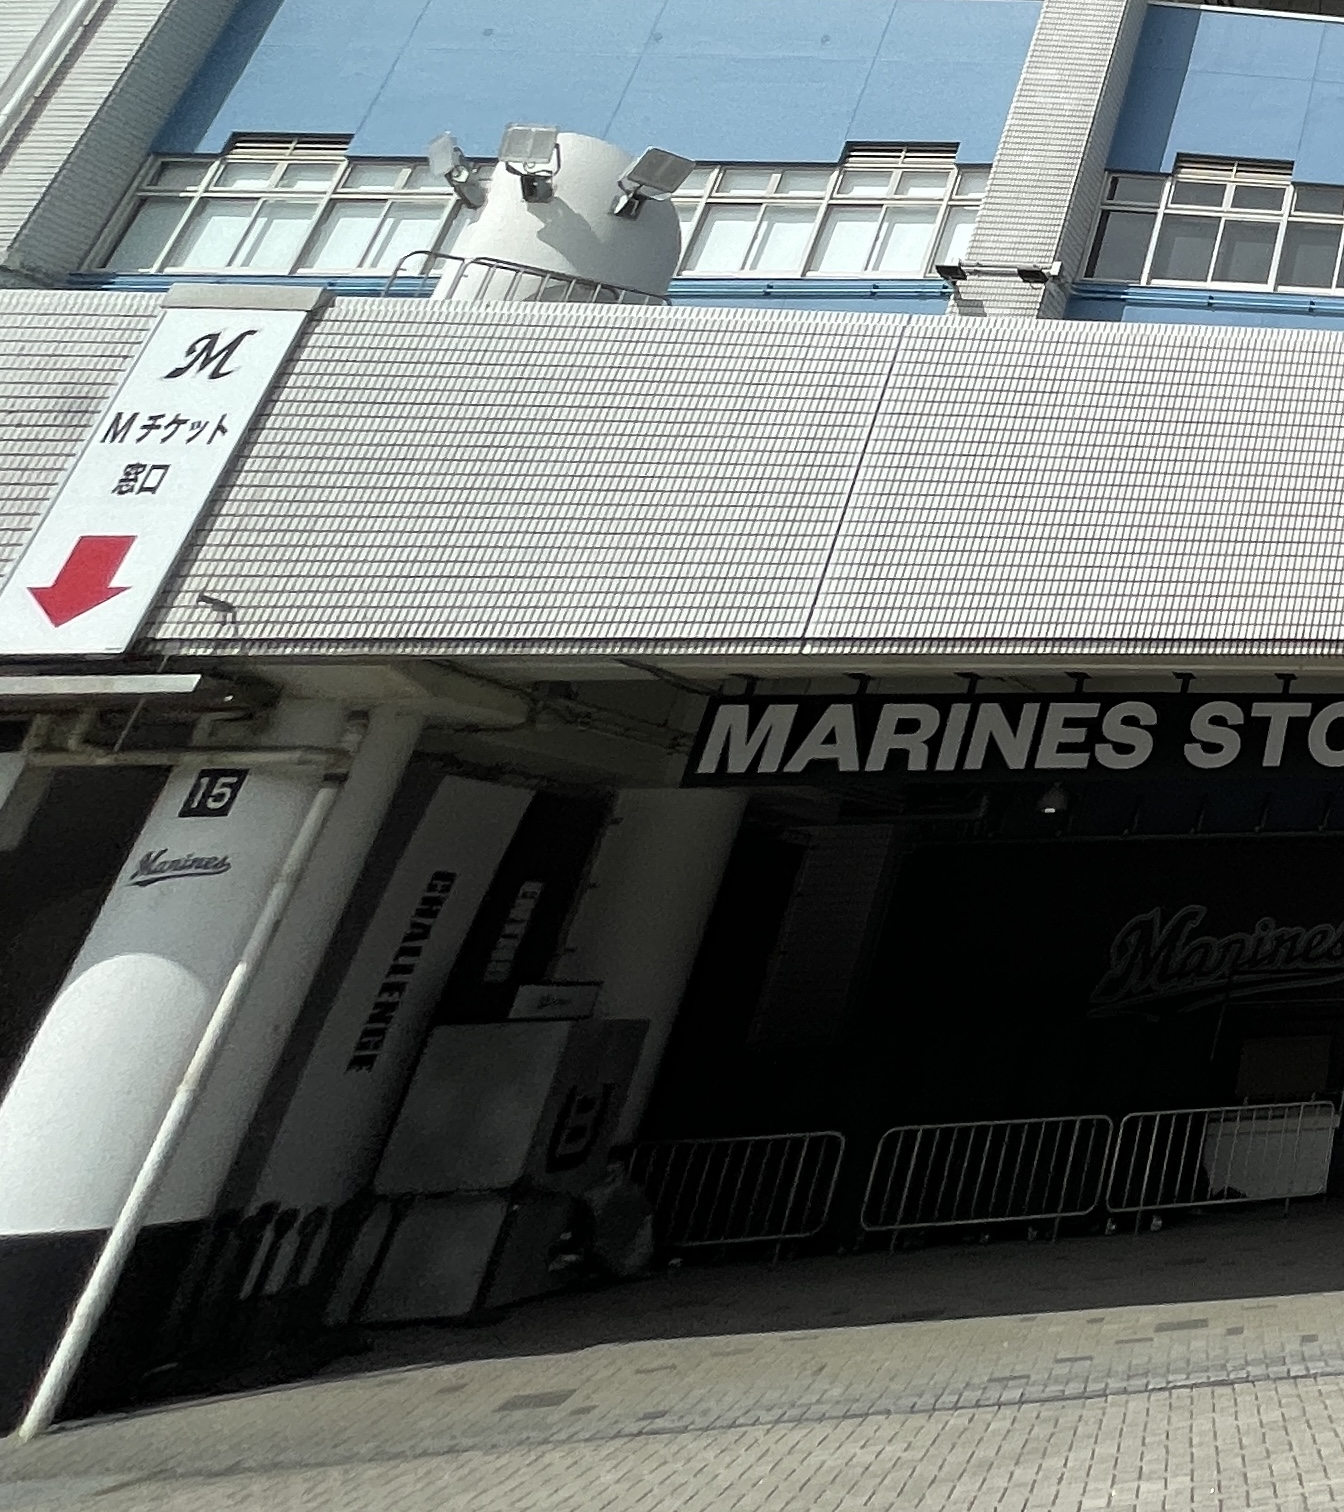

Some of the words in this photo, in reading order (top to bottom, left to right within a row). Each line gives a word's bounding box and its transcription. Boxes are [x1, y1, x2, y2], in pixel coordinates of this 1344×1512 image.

[162, 328, 259, 380] M
[111, 462, 172, 496] 窓口
[695, 700, 1158, 775] MARINES
[190, 776, 239, 811] 15
[128, 848, 232, 887] Marines
